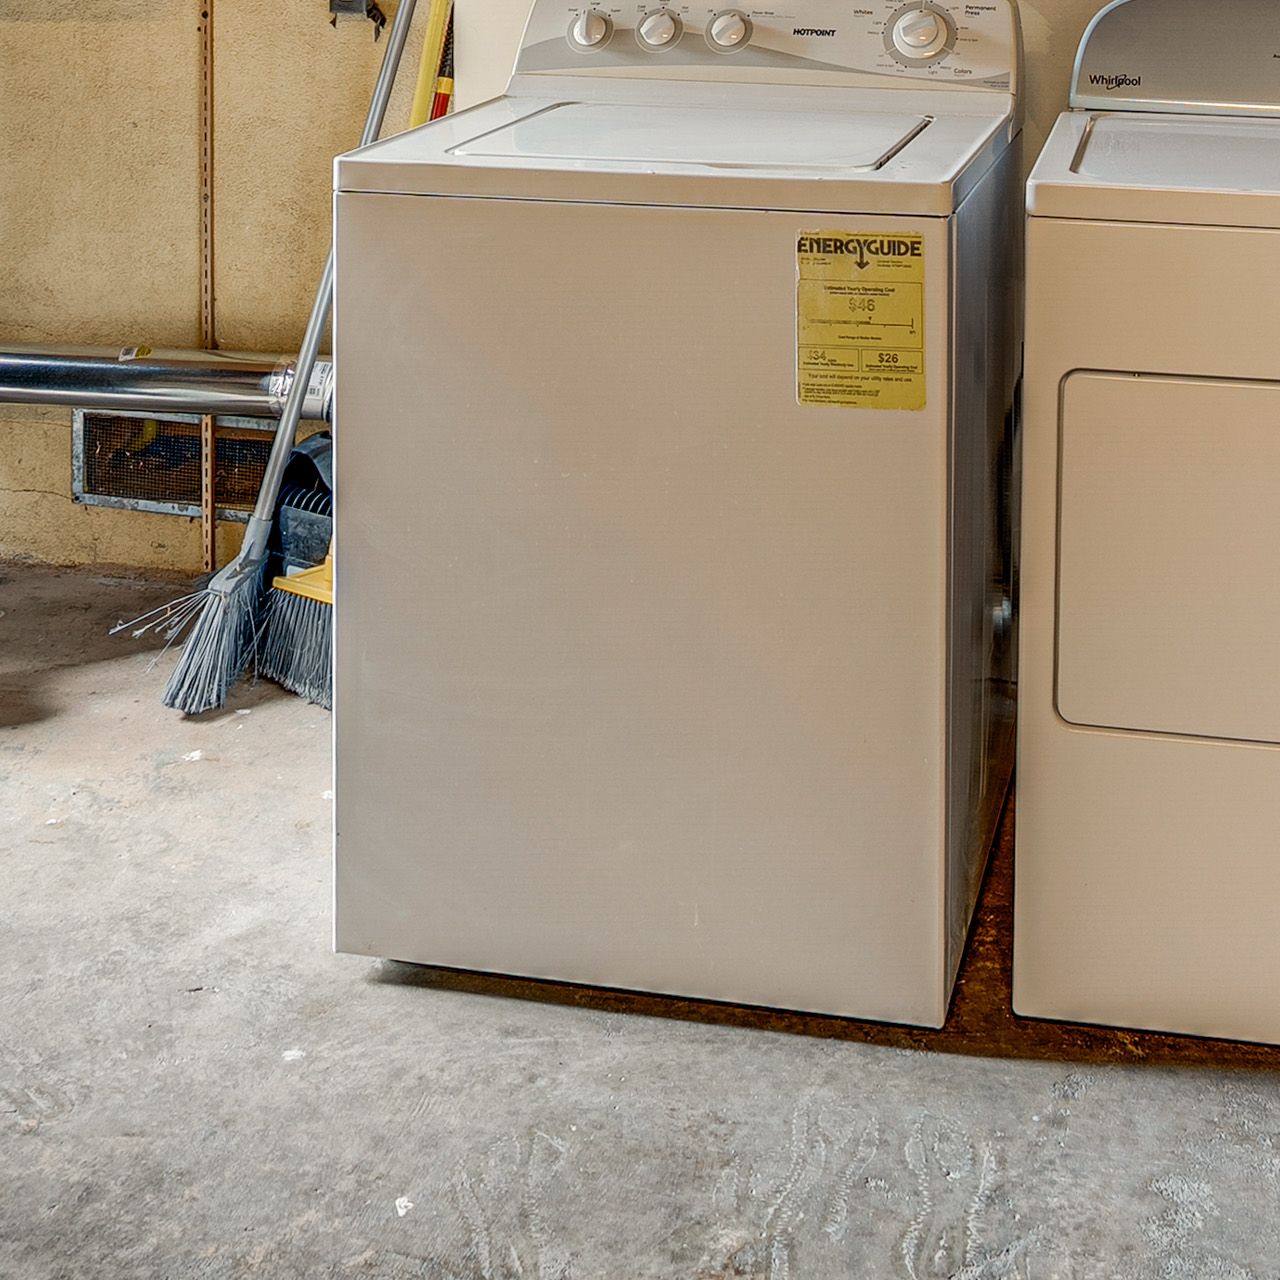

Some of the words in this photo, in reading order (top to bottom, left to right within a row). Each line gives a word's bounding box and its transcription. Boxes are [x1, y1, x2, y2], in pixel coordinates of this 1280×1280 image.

[793, 28, 837, 37] HOTPOINT
[1088, 74, 1141, 90] Whirlpool
[796, 237, 922, 261] ENERGYGUIDE
[877, 352, 899, 364] $26
